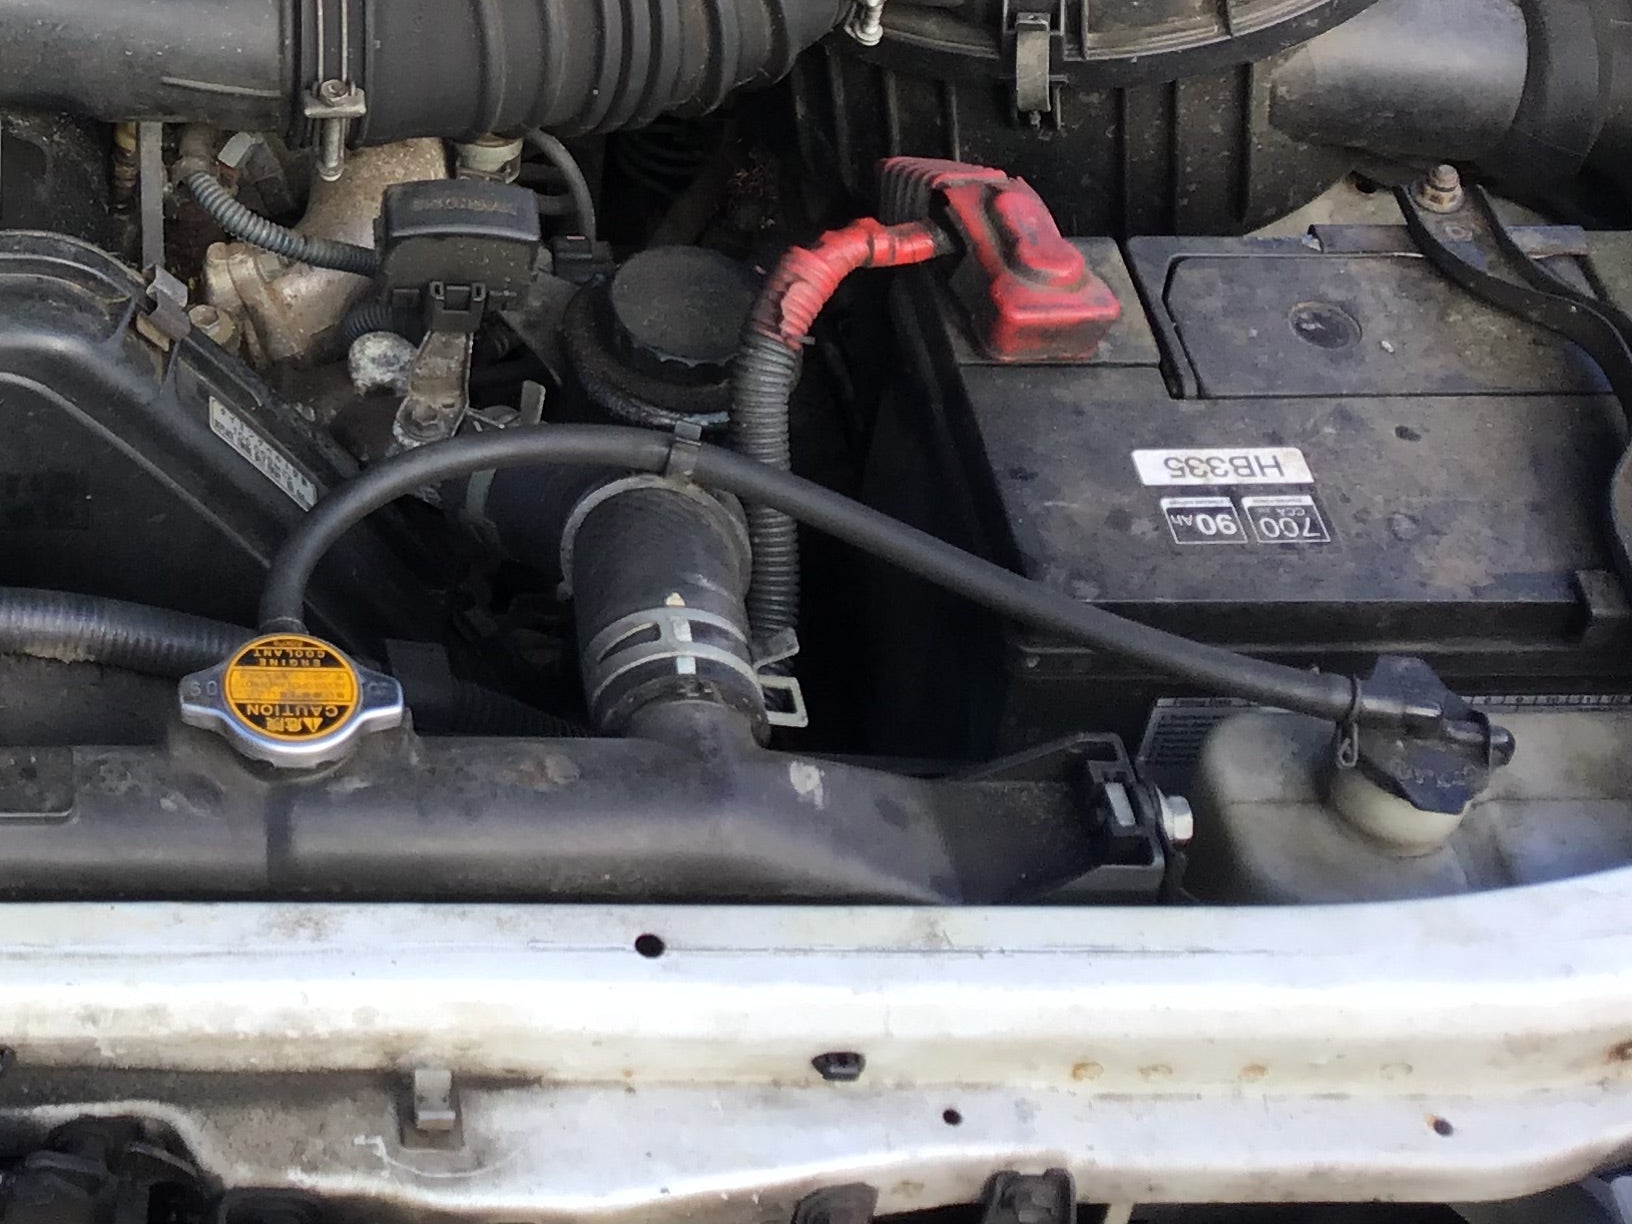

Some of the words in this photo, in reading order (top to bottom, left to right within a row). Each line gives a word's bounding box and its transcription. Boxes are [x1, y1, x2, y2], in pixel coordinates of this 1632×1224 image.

[1164, 455, 1286, 478] HB335
[1259, 516, 1321, 538] 700
[252, 650, 326, 659] COOLANT
[258, 658, 322, 667] ENGINE
[246, 704, 339, 717] CAUTION
